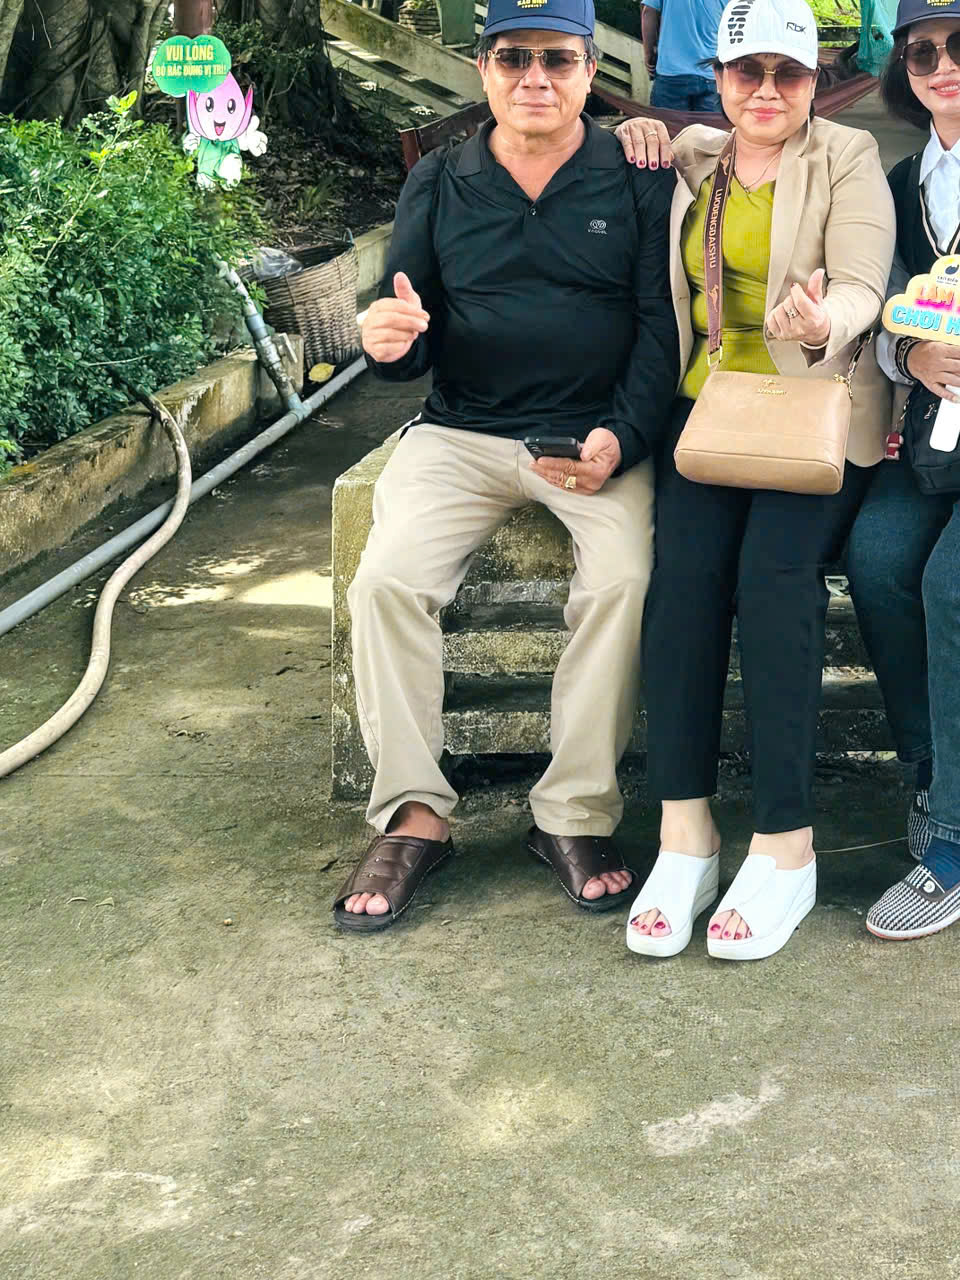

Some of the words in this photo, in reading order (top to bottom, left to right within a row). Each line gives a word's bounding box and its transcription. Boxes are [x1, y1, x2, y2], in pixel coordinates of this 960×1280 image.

[166, 45, 183, 60] VUI
[186, 41, 213, 60] LÒNG
[708, 188, 722, 268] LUODENGDAISHU
[892, 305, 942, 331] CHƠI
